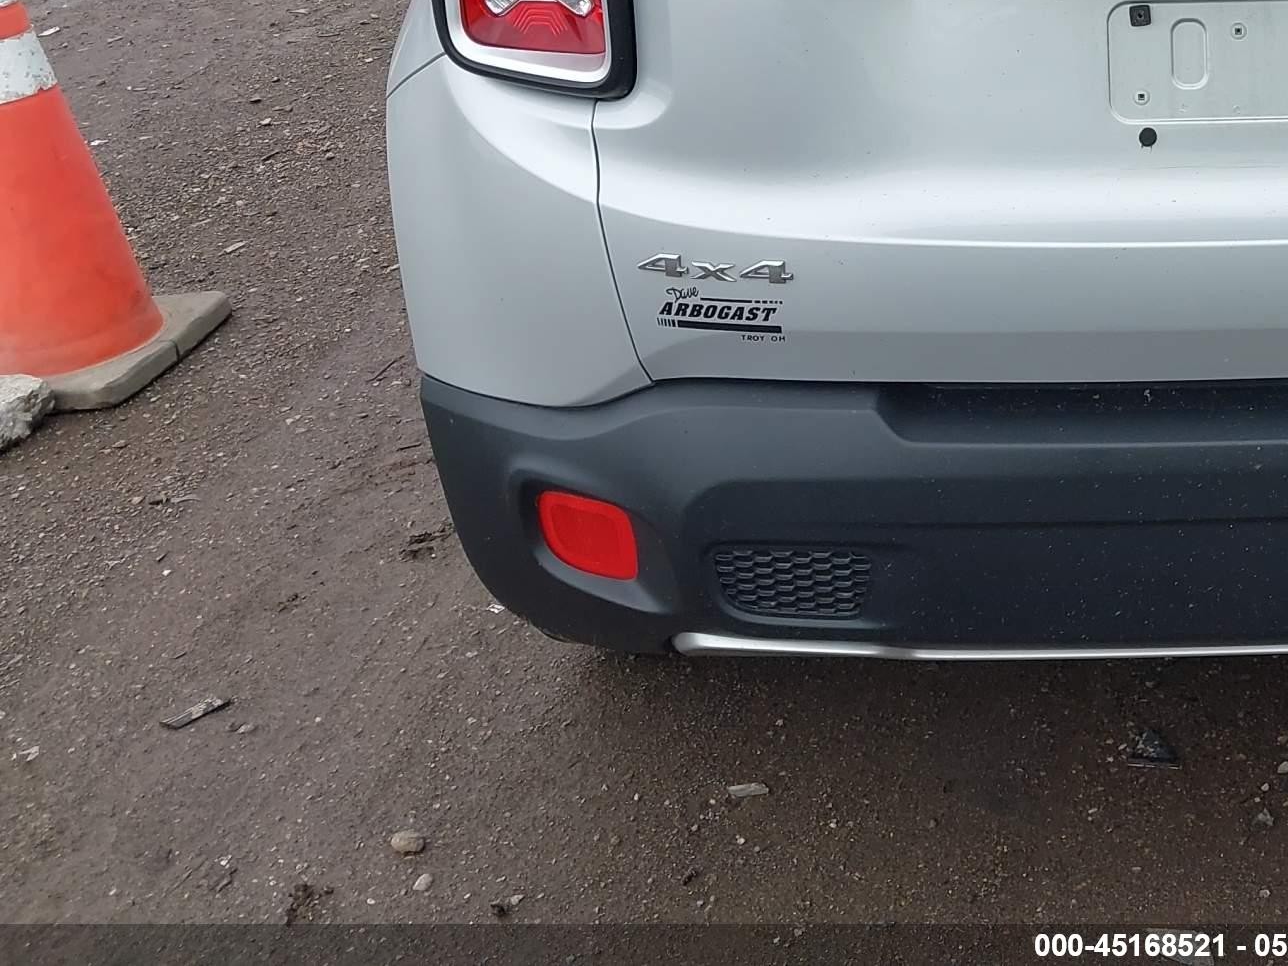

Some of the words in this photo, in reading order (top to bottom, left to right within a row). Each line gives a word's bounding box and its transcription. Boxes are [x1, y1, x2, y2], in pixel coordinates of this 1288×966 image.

[665, 286, 700, 304] Dave
[659, 301, 778, 322] ARBOGAST
[741, 334, 765, 342] TROY
